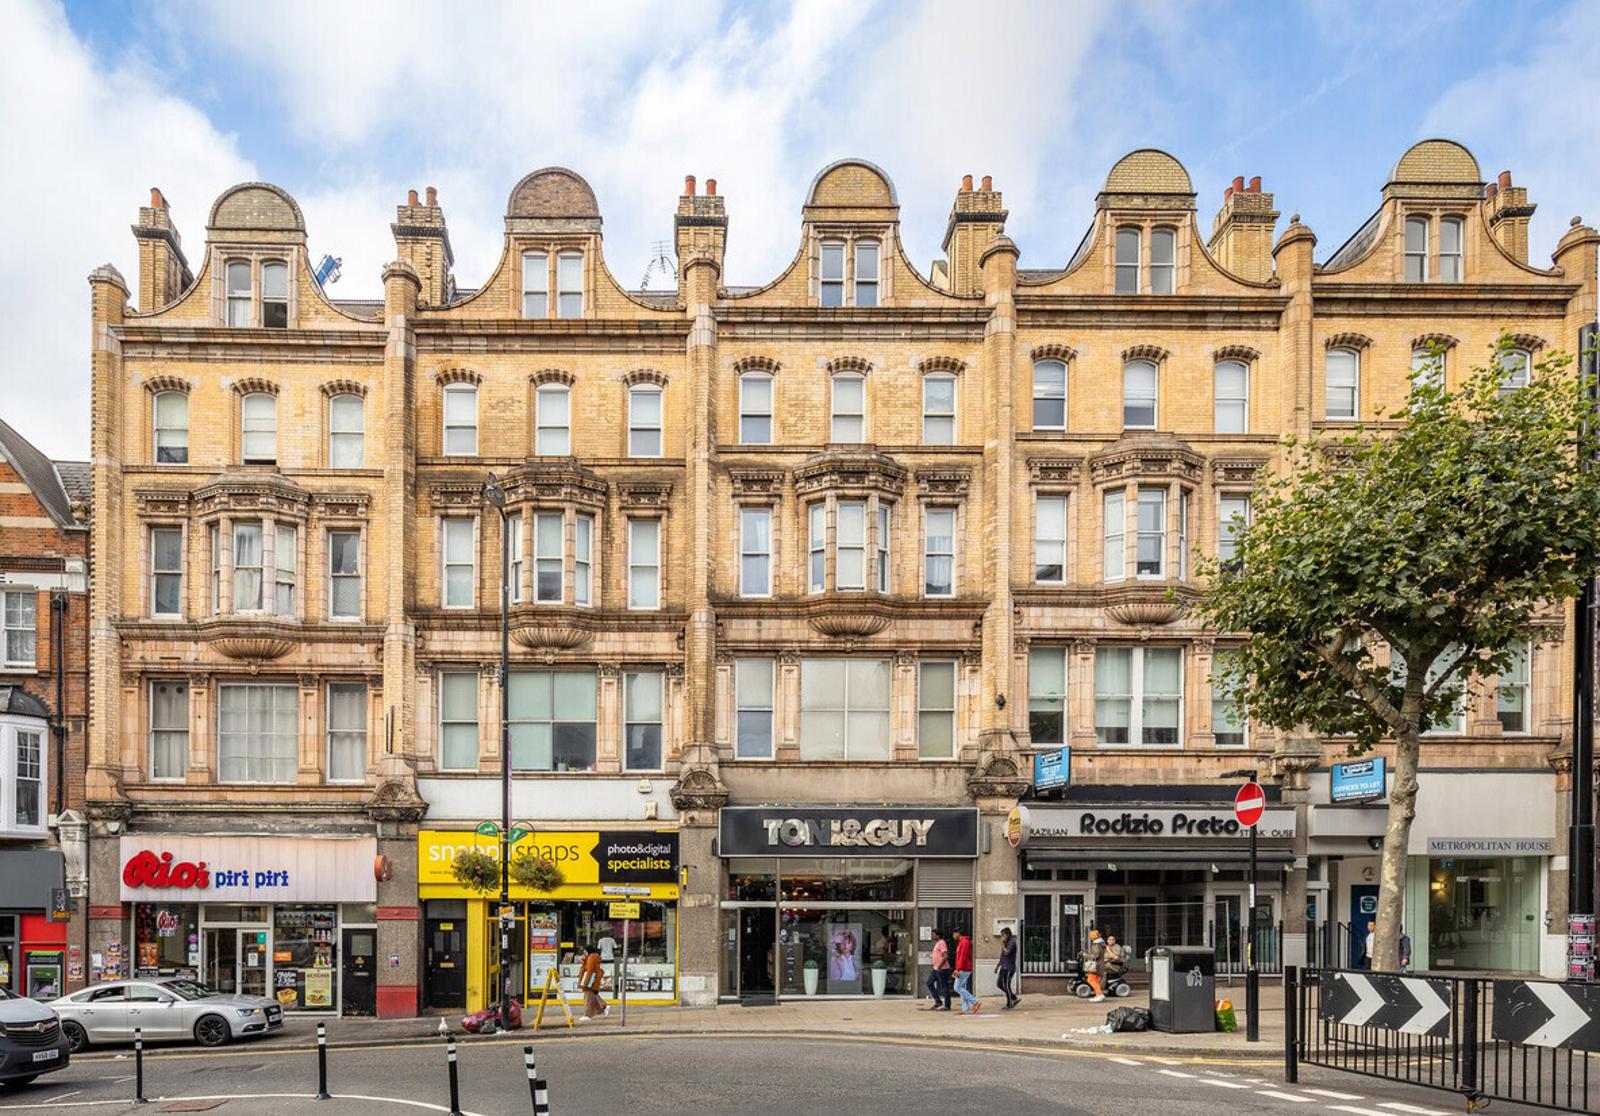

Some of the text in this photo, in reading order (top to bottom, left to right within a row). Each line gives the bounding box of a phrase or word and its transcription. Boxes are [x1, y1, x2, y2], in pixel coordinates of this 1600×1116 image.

[763, 818, 935, 847] TONI&GUY
[1029, 828, 1068, 836] RAZILIAN
[1080, 813, 1240, 834] Rodizio Preto
[607, 843, 671, 857] photo&digital
[1430, 841, 1552, 851] METROPOLITAN HOUSE
[515, 844, 580, 867] snaps
[123, 850, 209, 889] Rio's
[607, 857, 671, 873] specialists
[215, 870, 288, 888] piri piri
